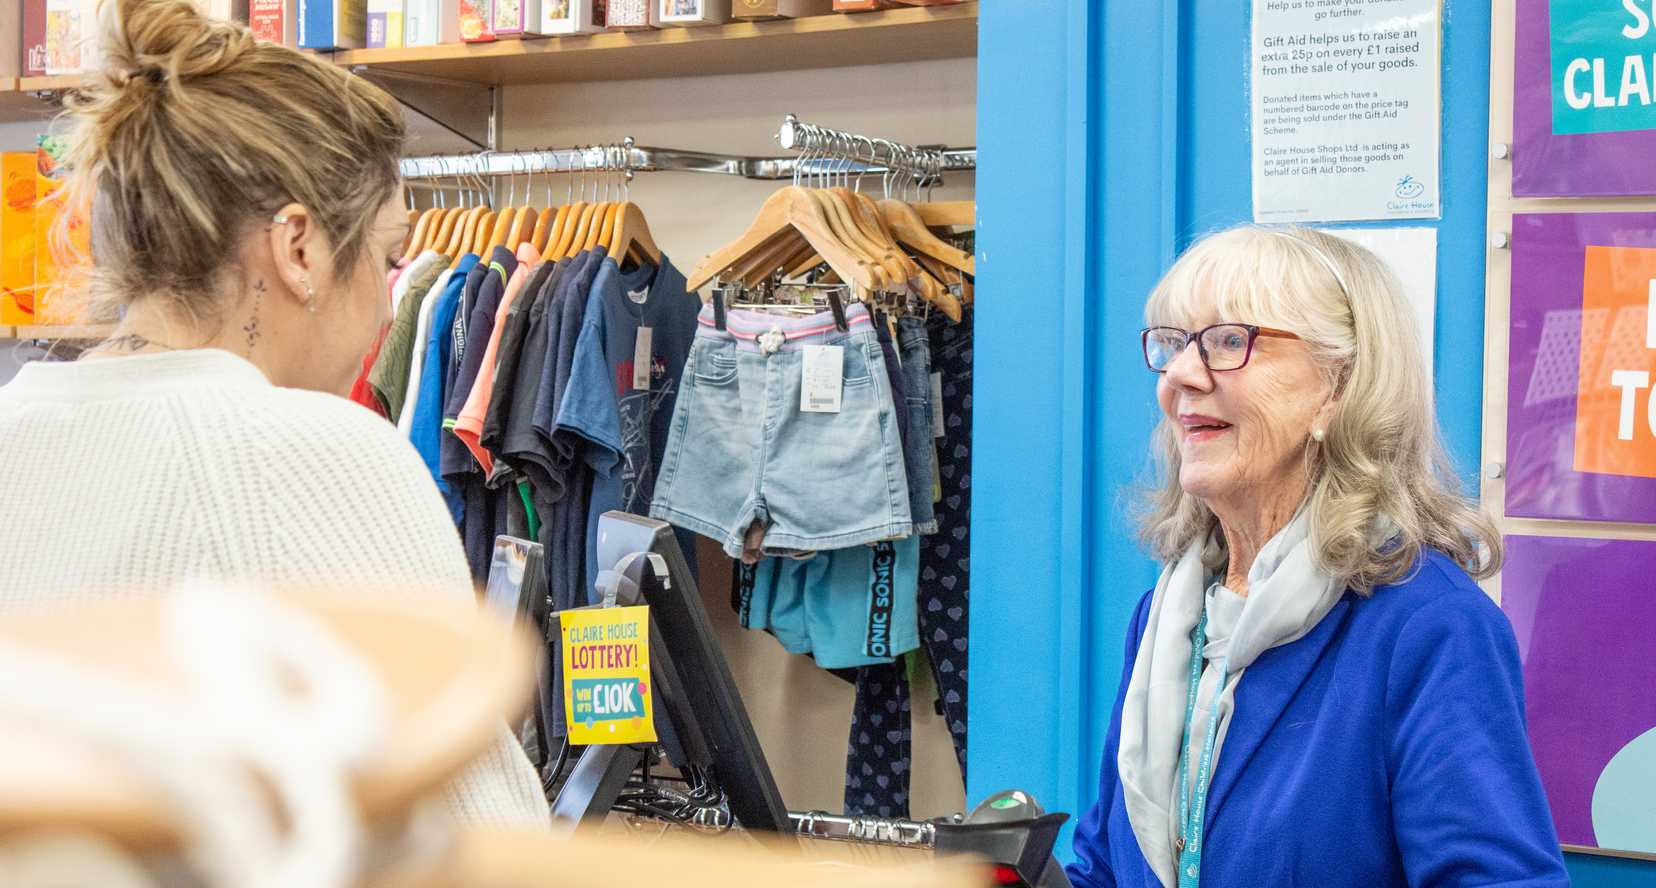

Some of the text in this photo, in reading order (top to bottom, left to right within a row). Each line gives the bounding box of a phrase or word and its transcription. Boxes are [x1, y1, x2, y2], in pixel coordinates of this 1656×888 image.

[1267, 2, 1289, 12] Help
[1314, 8, 1365, 21] go further.
[1622, 0, 1656, 39] S
[1264, 30, 1417, 48] Gift Aid helps us to raise an
[1261, 52, 1288, 62] extra
[1292, 49, 1313, 62] 25p
[1333, 48, 1363, 58] every
[1367, 44, 1381, 55] £1
[1384, 42, 1419, 54] raised
[1262, 57, 1418, 76] from the sale of your goods.
[1564, 53, 1656, 109] CLA
[1264, 106, 1304, 114] numbered
[1306, 104, 1340, 112] barcode
[1355, 101, 1369, 109] the
[1371, 100, 1393, 110] price
[1395, 99, 1408, 109] tag
[1278, 115, 1301, 125] being
[1304, 113, 1320, 122] sold
[1322, 112, 1347, 121] under
[1349, 111, 1363, 120] the
[1365, 110, 1381, 120] Gift
[1383, 110, 1398, 118] Aid
[1264, 147, 1287, 155] Claire
[1290, 145, 1315, 154] House
[1317, 144, 1343, 154] Shops
[1372, 141, 1398, 152] acting
[1276, 157, 1299, 166] agent
[1310, 155, 1337, 165] selling
[1340, 154, 1362, 162] those
[1364, 153, 1390, 163] goods
[1264, 168, 1289, 177] behalf
[1291, 167, 1300, 175] of
[1302, 166, 1317, 175] Gift
[1320, 165, 1333, 174] Aid
[876, 555, 891, 608] SONIC
[570, 622, 638, 642] CLAIRE HOUSE
[572, 644, 638, 670] LOTTERY!
[594, 682, 637, 714] £10K
